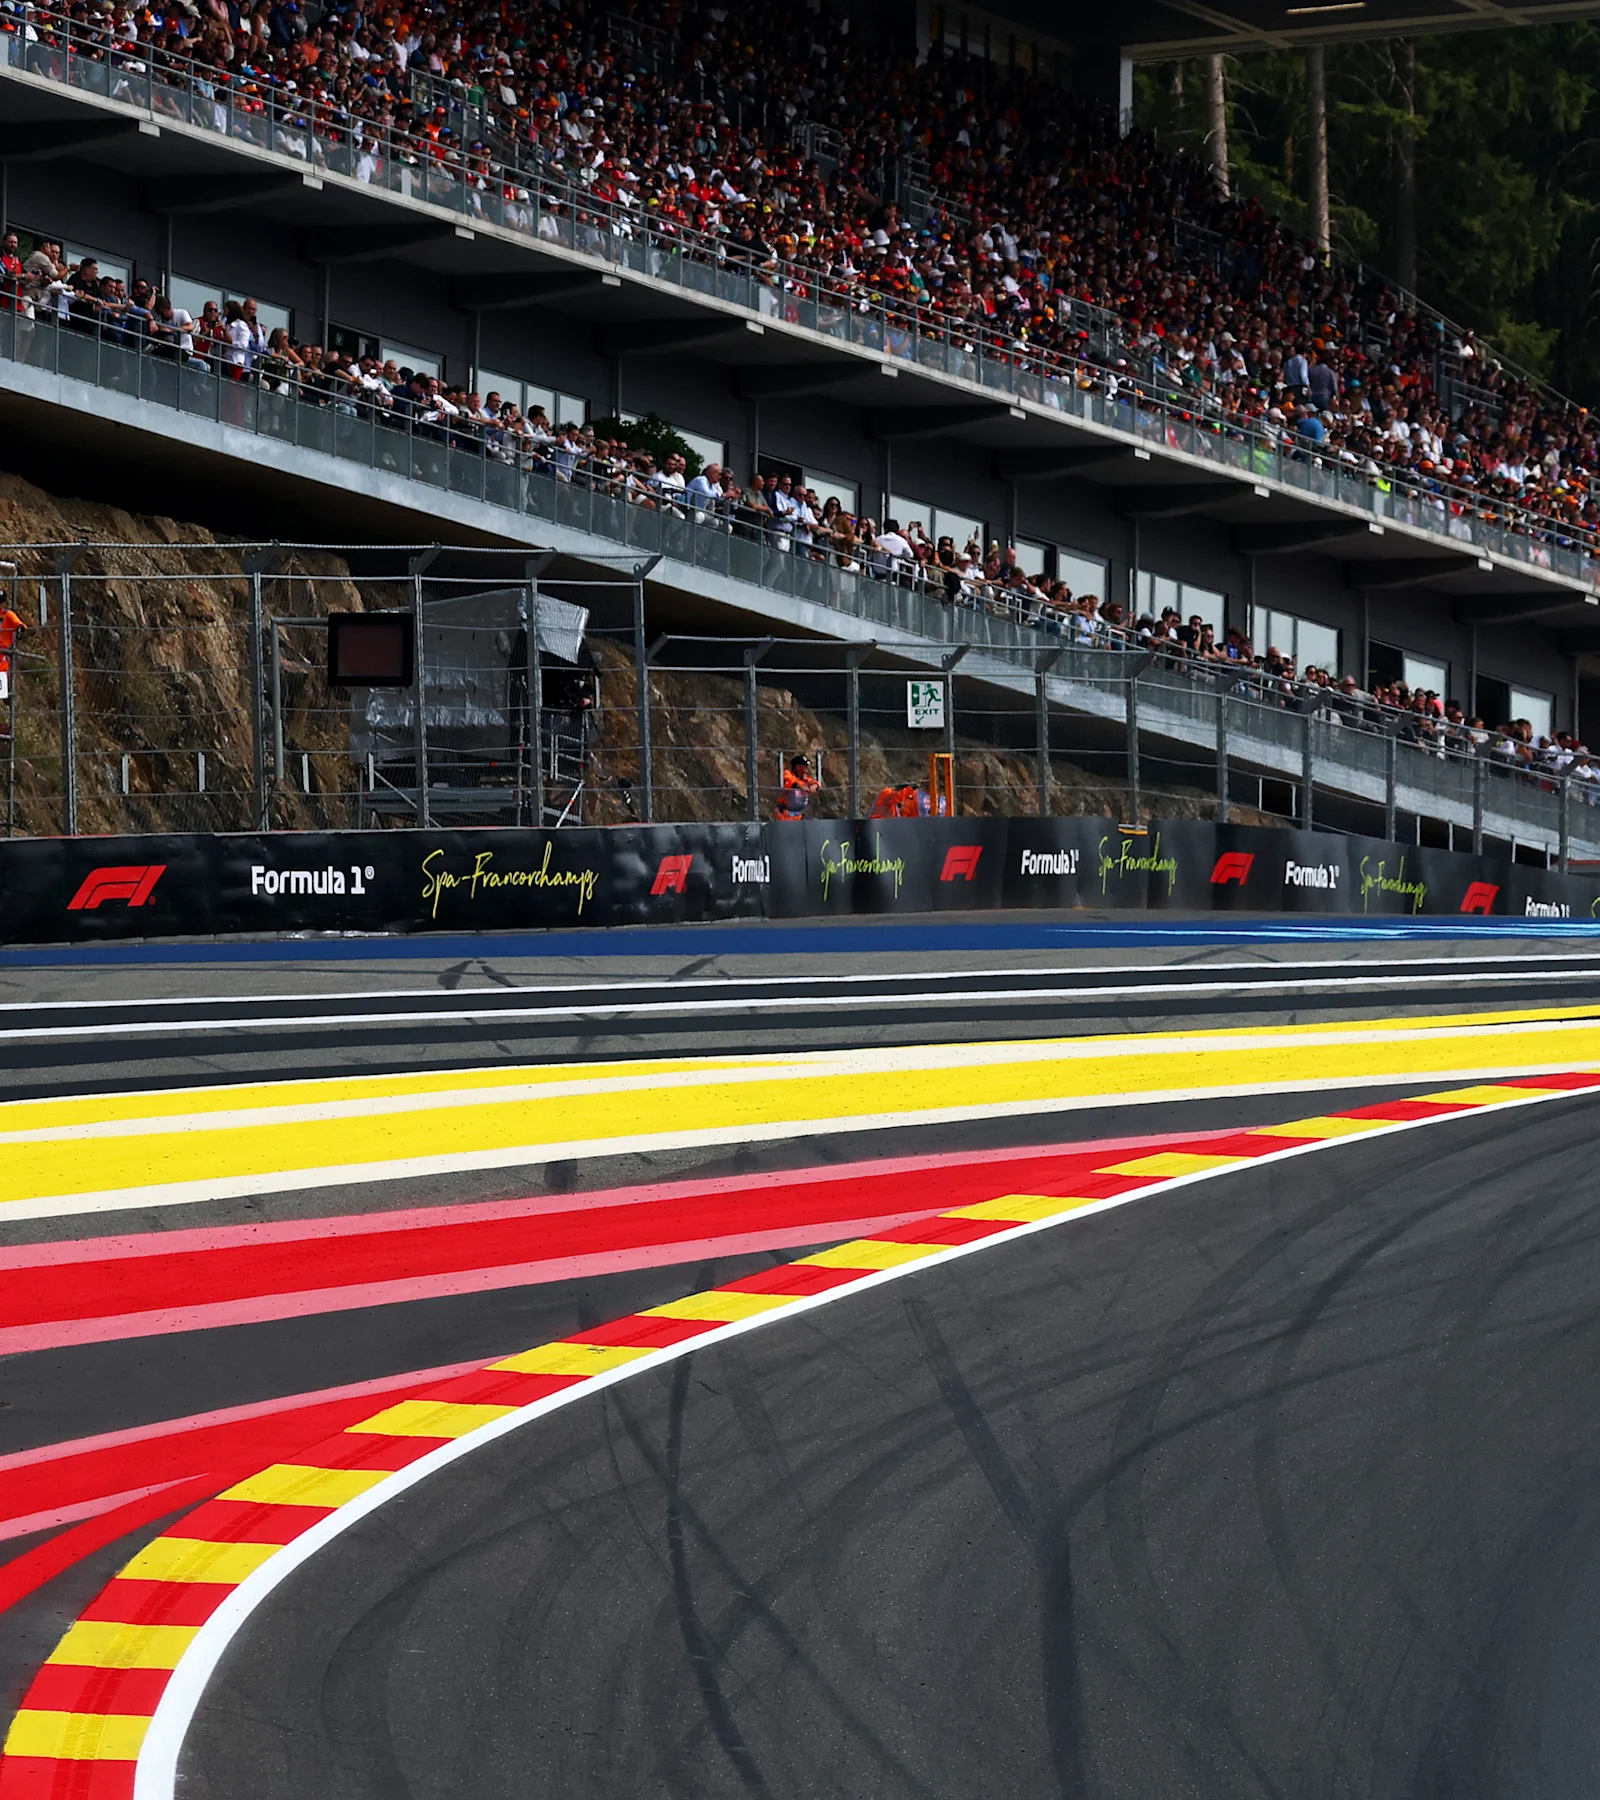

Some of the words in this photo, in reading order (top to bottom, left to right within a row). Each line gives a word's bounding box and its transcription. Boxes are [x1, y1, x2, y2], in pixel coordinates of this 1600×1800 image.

[731, 854, 765, 883] Formula
[1020, 849, 1070, 875] Formula
[1284, 860, 1329, 888] Formula
[251, 865, 346, 895] Formula
[422, 841, 599, 919] Spa-Francorchamps
